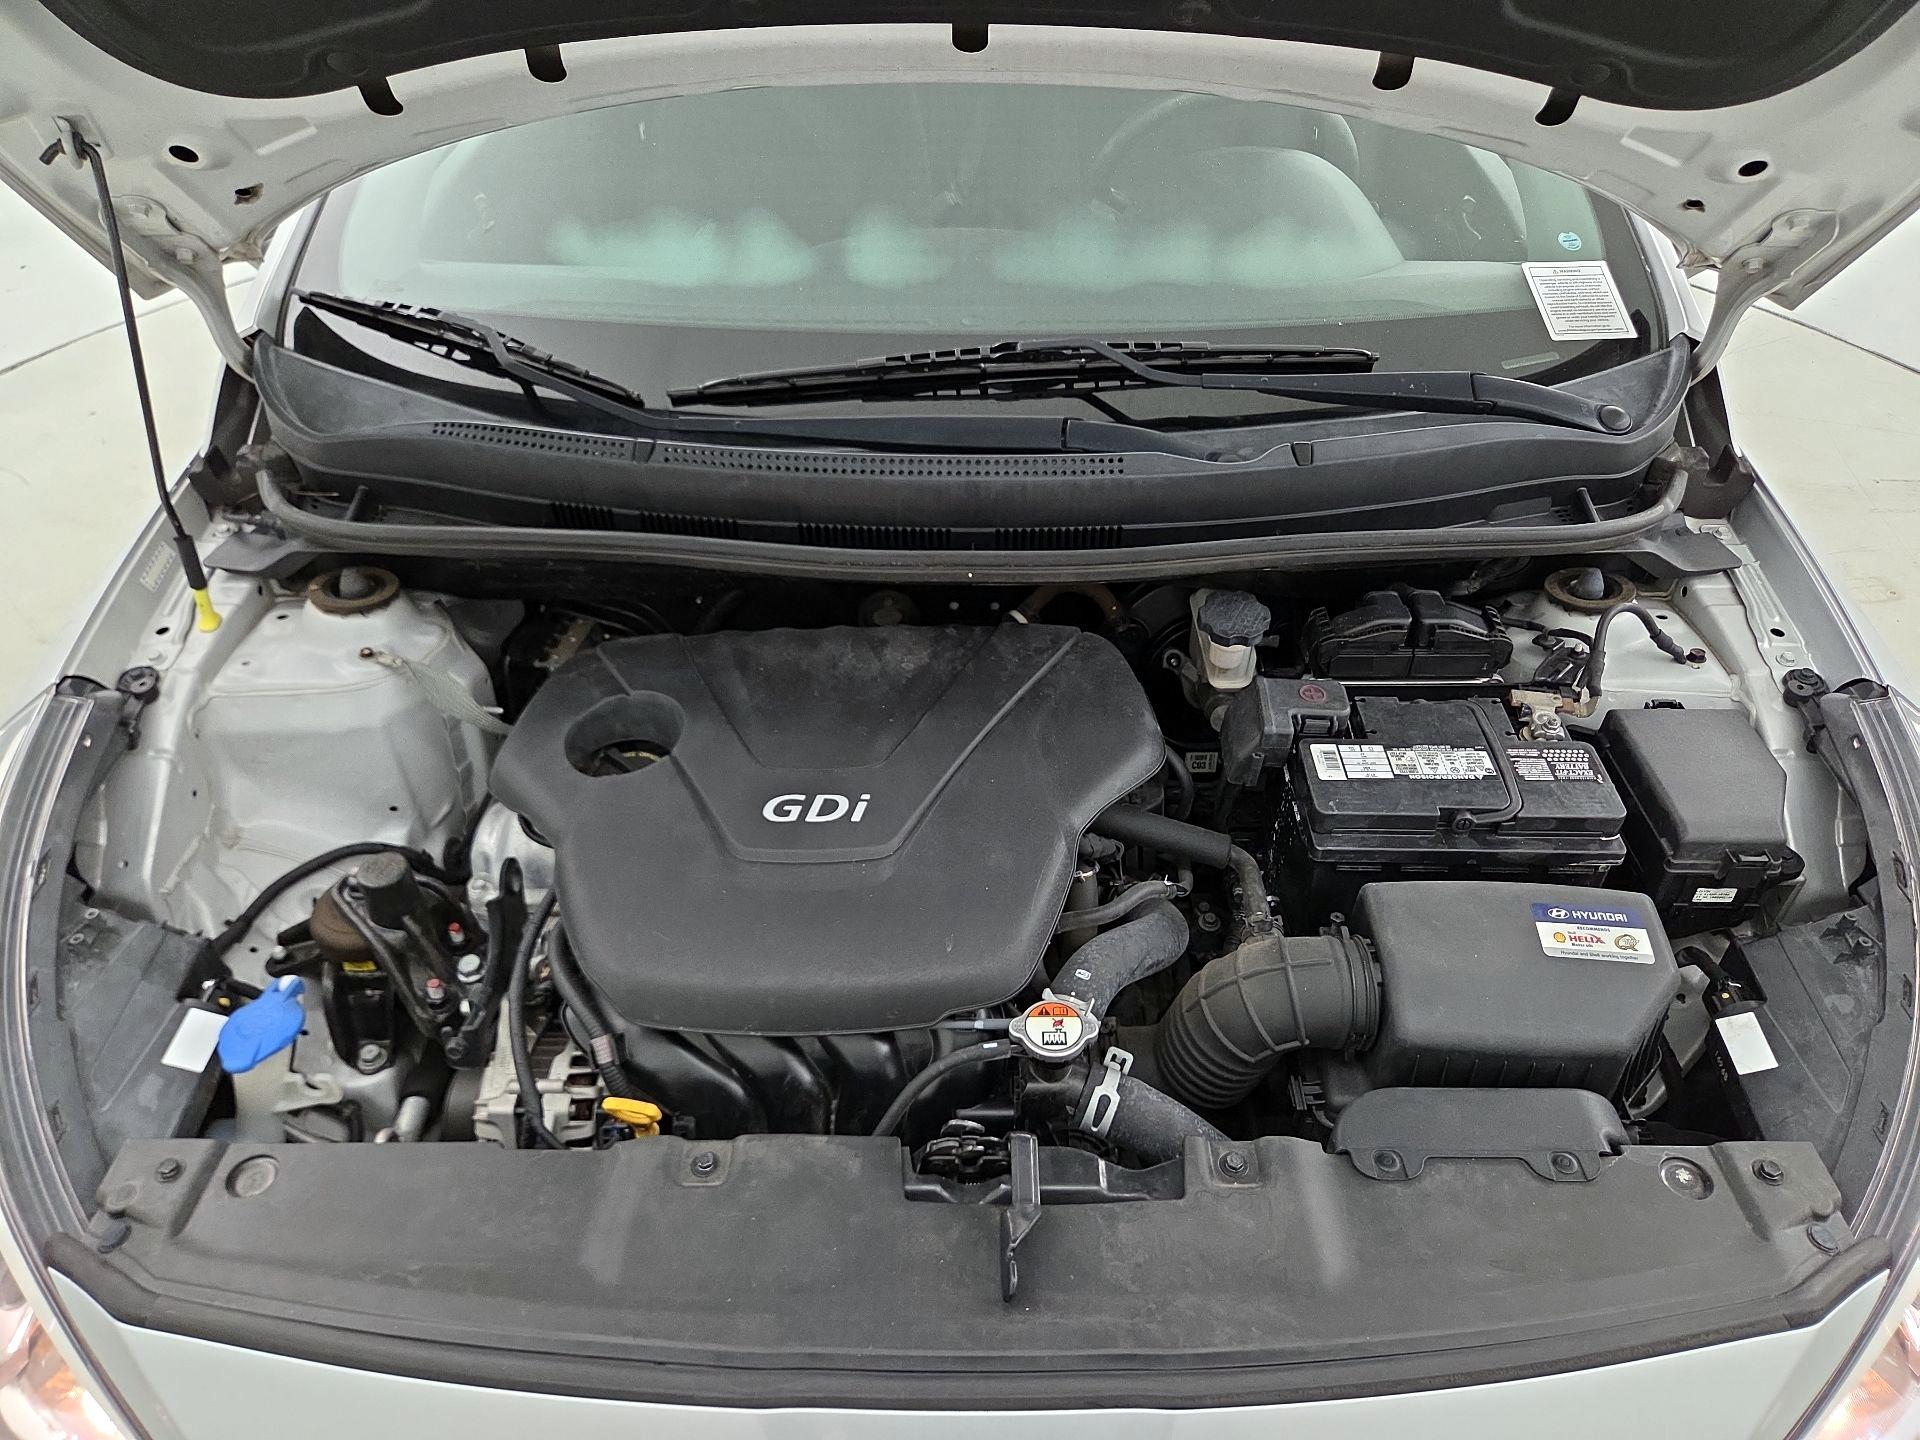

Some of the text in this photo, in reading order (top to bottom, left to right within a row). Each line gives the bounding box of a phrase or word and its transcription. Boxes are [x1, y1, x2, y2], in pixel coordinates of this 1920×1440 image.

[762, 793, 871, 823] GDi
[1572, 911, 1628, 922] HYUNDAI
[1568, 933, 1606, 944] HELIX
